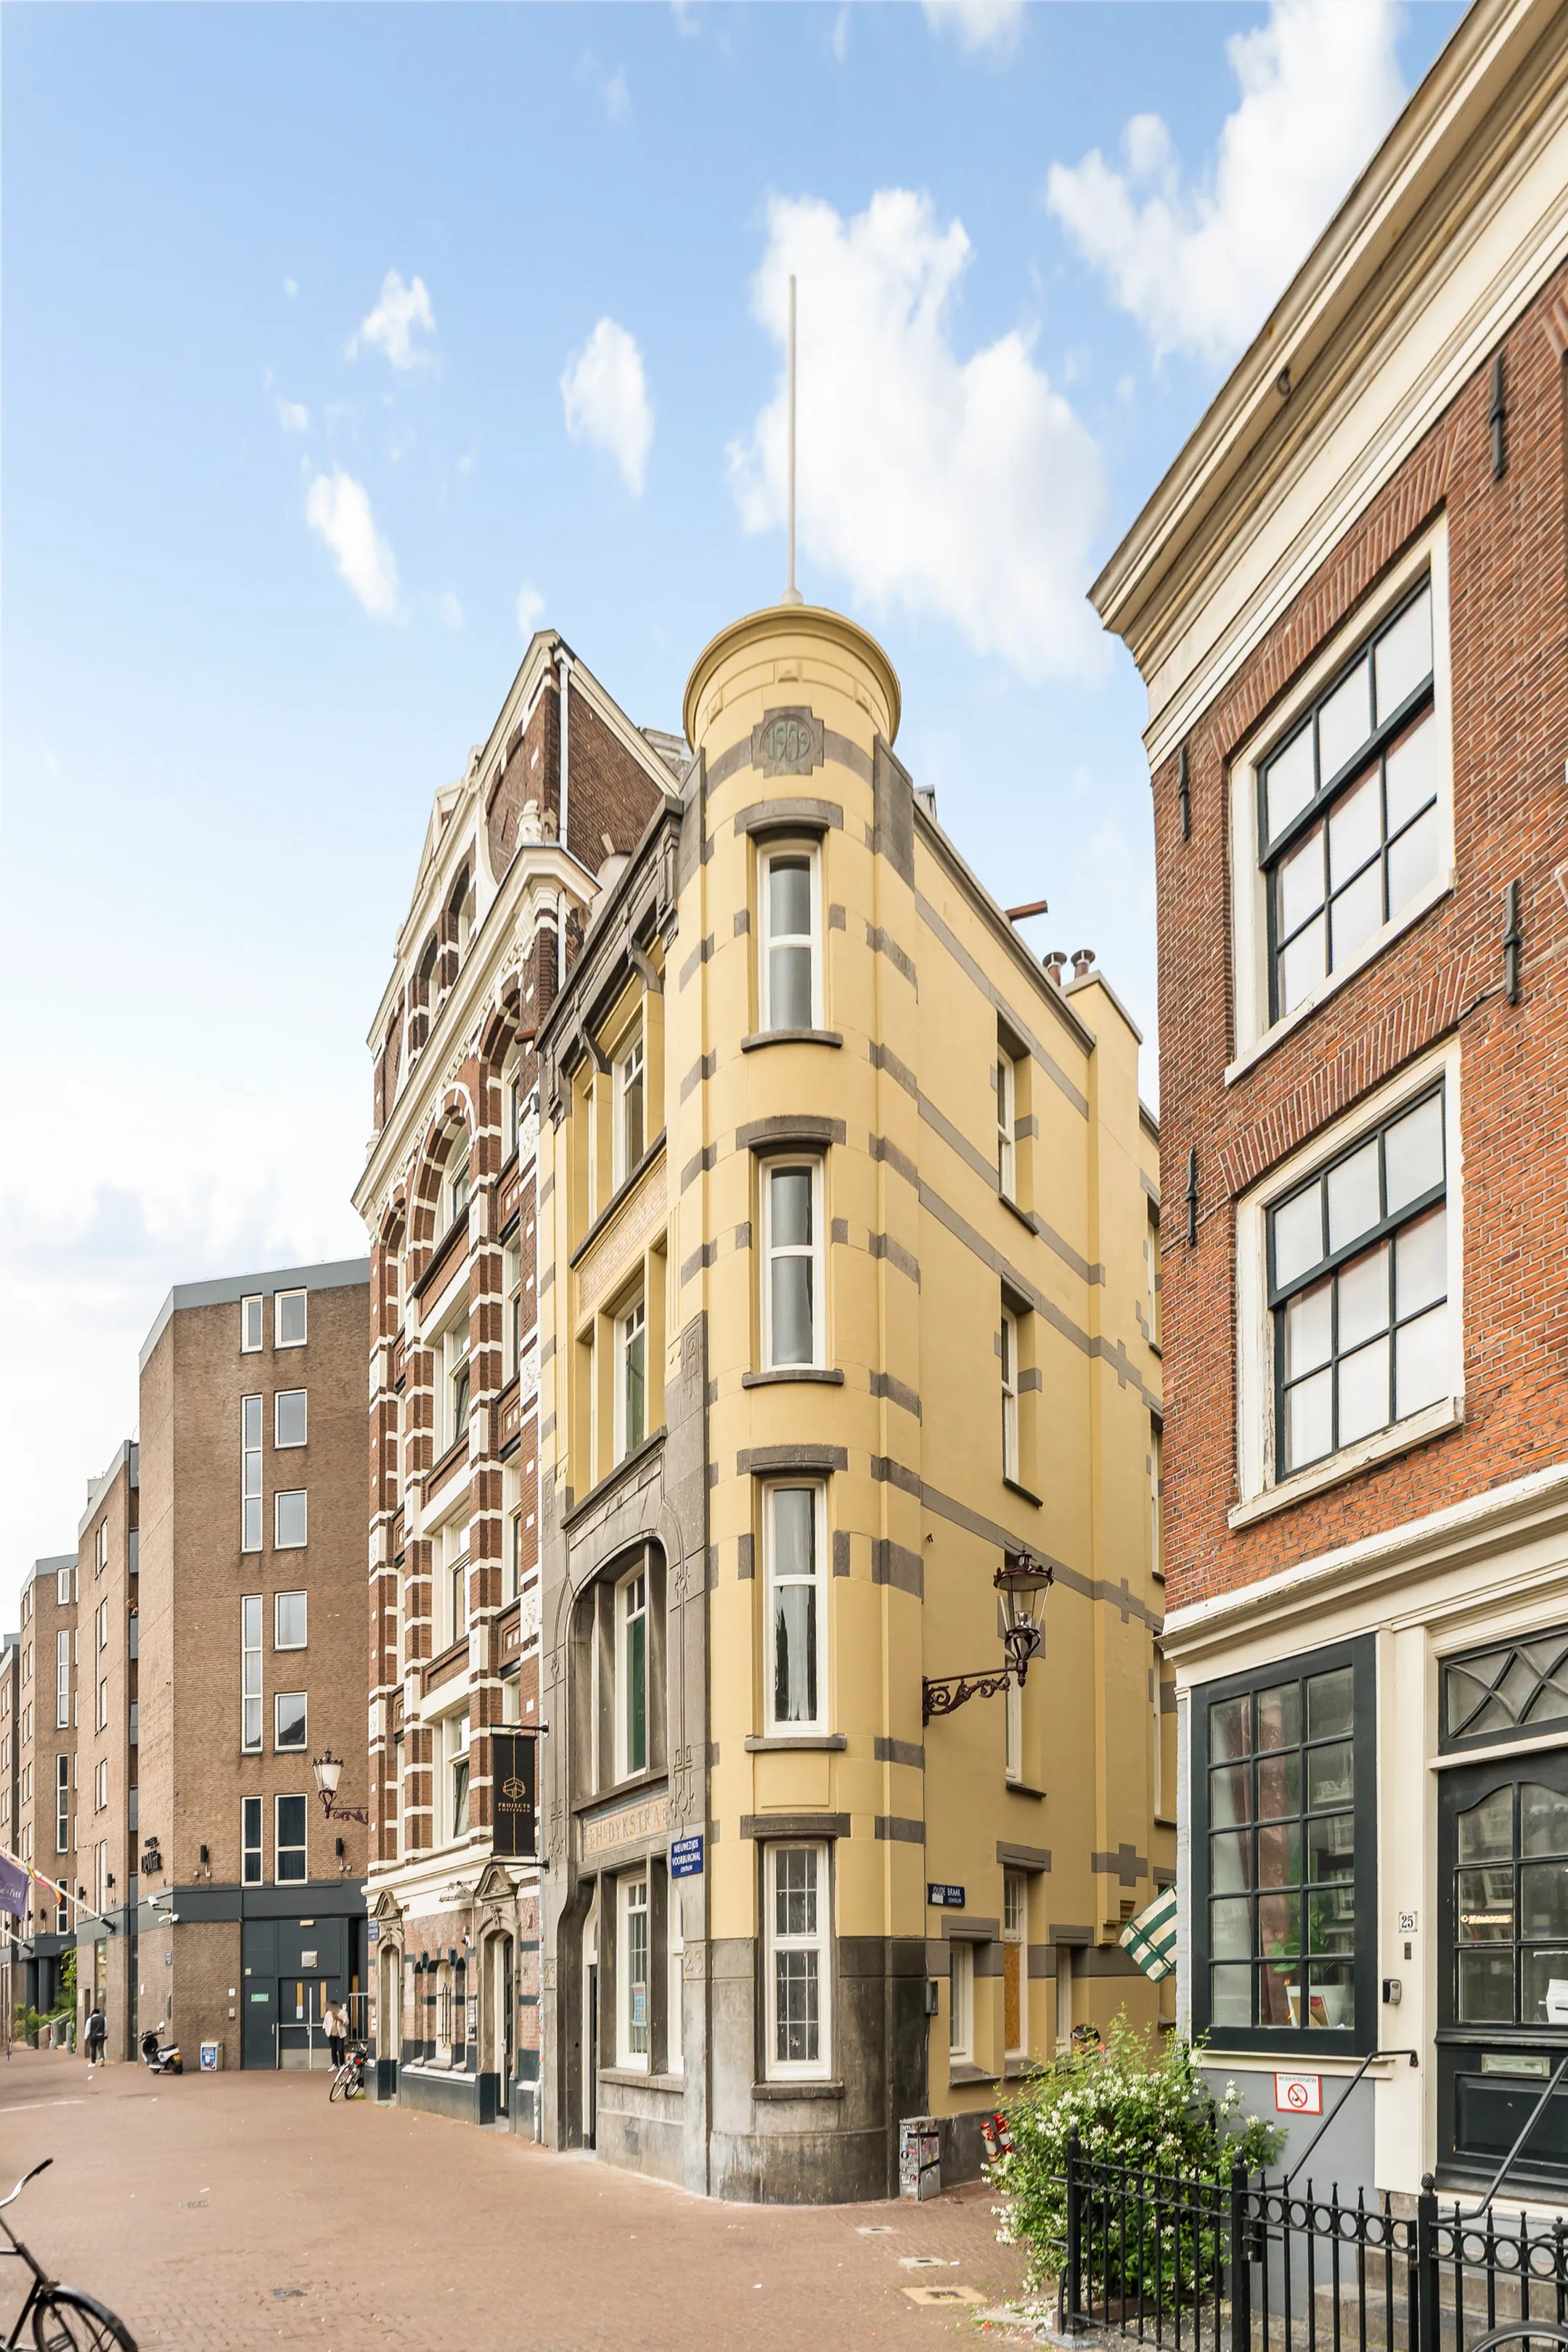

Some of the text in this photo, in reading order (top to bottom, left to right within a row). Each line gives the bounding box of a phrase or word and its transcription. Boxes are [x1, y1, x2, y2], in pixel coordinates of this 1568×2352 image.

[609, 1803, 661, 1842] DYKSTRA
[674, 1839, 699, 1853] NIEUWEZIJDS
[672, 1852, 701, 1866] VOORBURGWAL
[933, 1886, 961, 1897] OUDE BRAAK
[1402, 1915, 1413, 1928] 25
[685, 1951, 703, 1973] 23
[544, 1966, 556, 1984] 23
